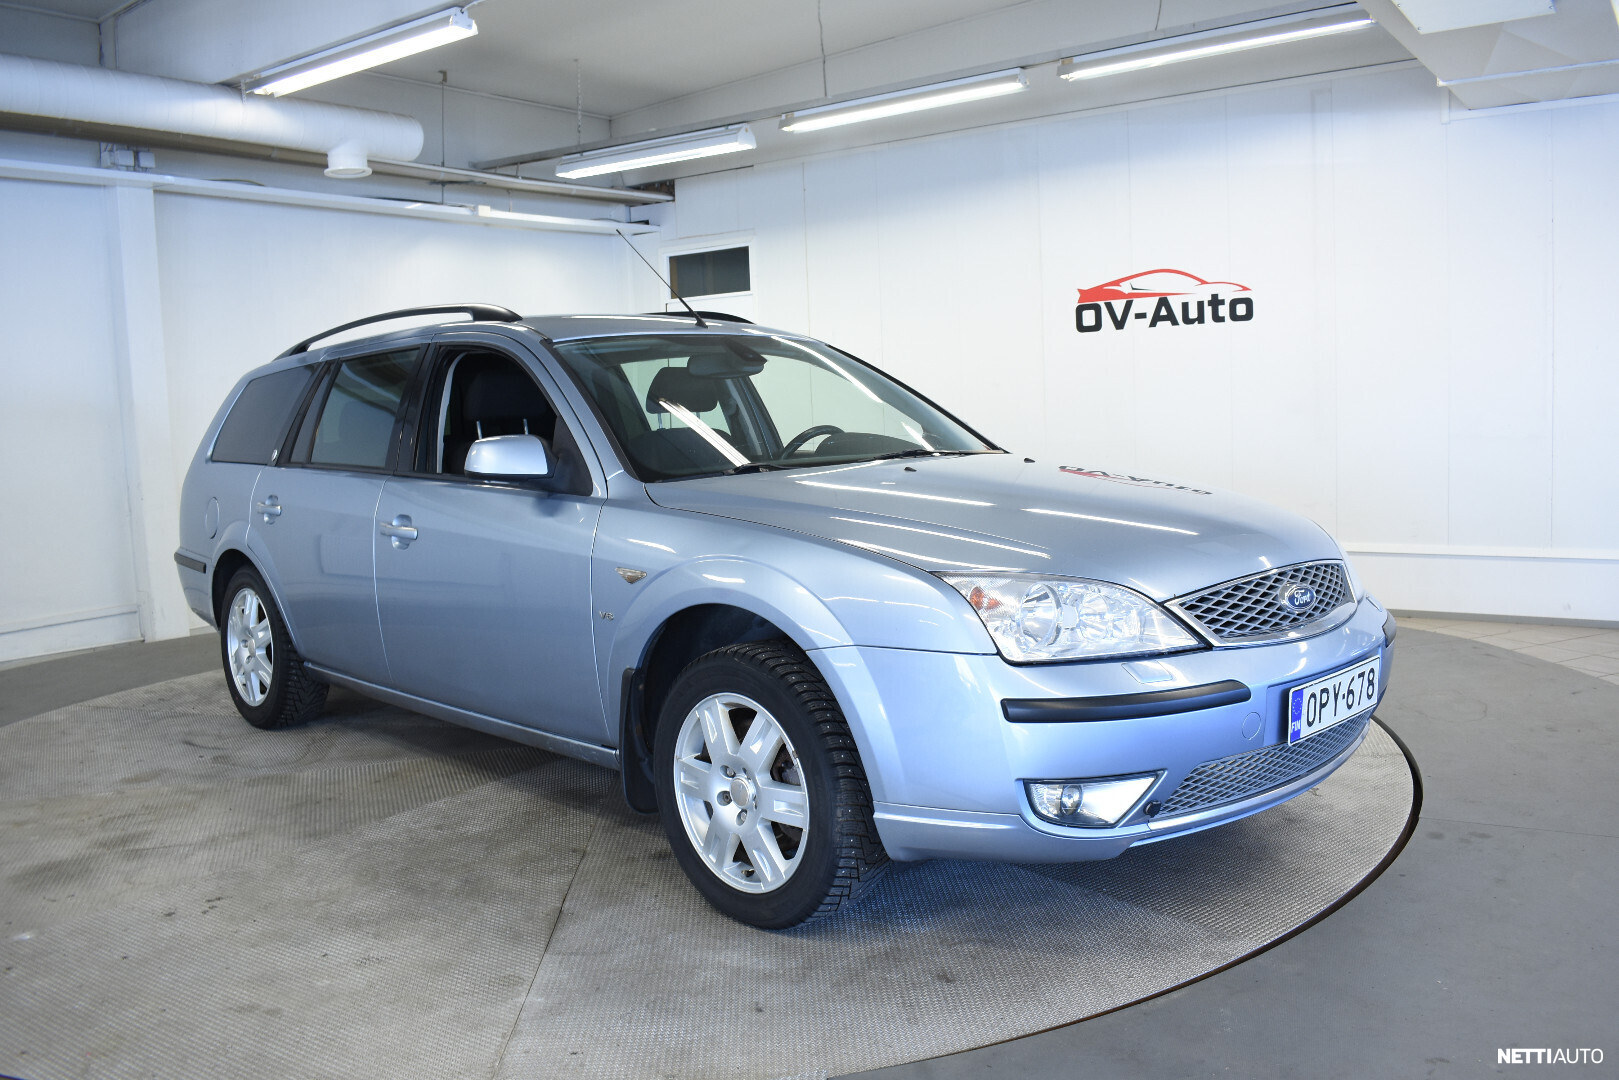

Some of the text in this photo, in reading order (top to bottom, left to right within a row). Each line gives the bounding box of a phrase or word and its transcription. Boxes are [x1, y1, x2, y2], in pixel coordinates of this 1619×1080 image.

[1075, 294, 1254, 333] OV-Auto
[1294, 588, 1311, 605] Ford
[1306, 667, 1375, 727] OPY-678
[1291, 719, 1301, 734] FIN
